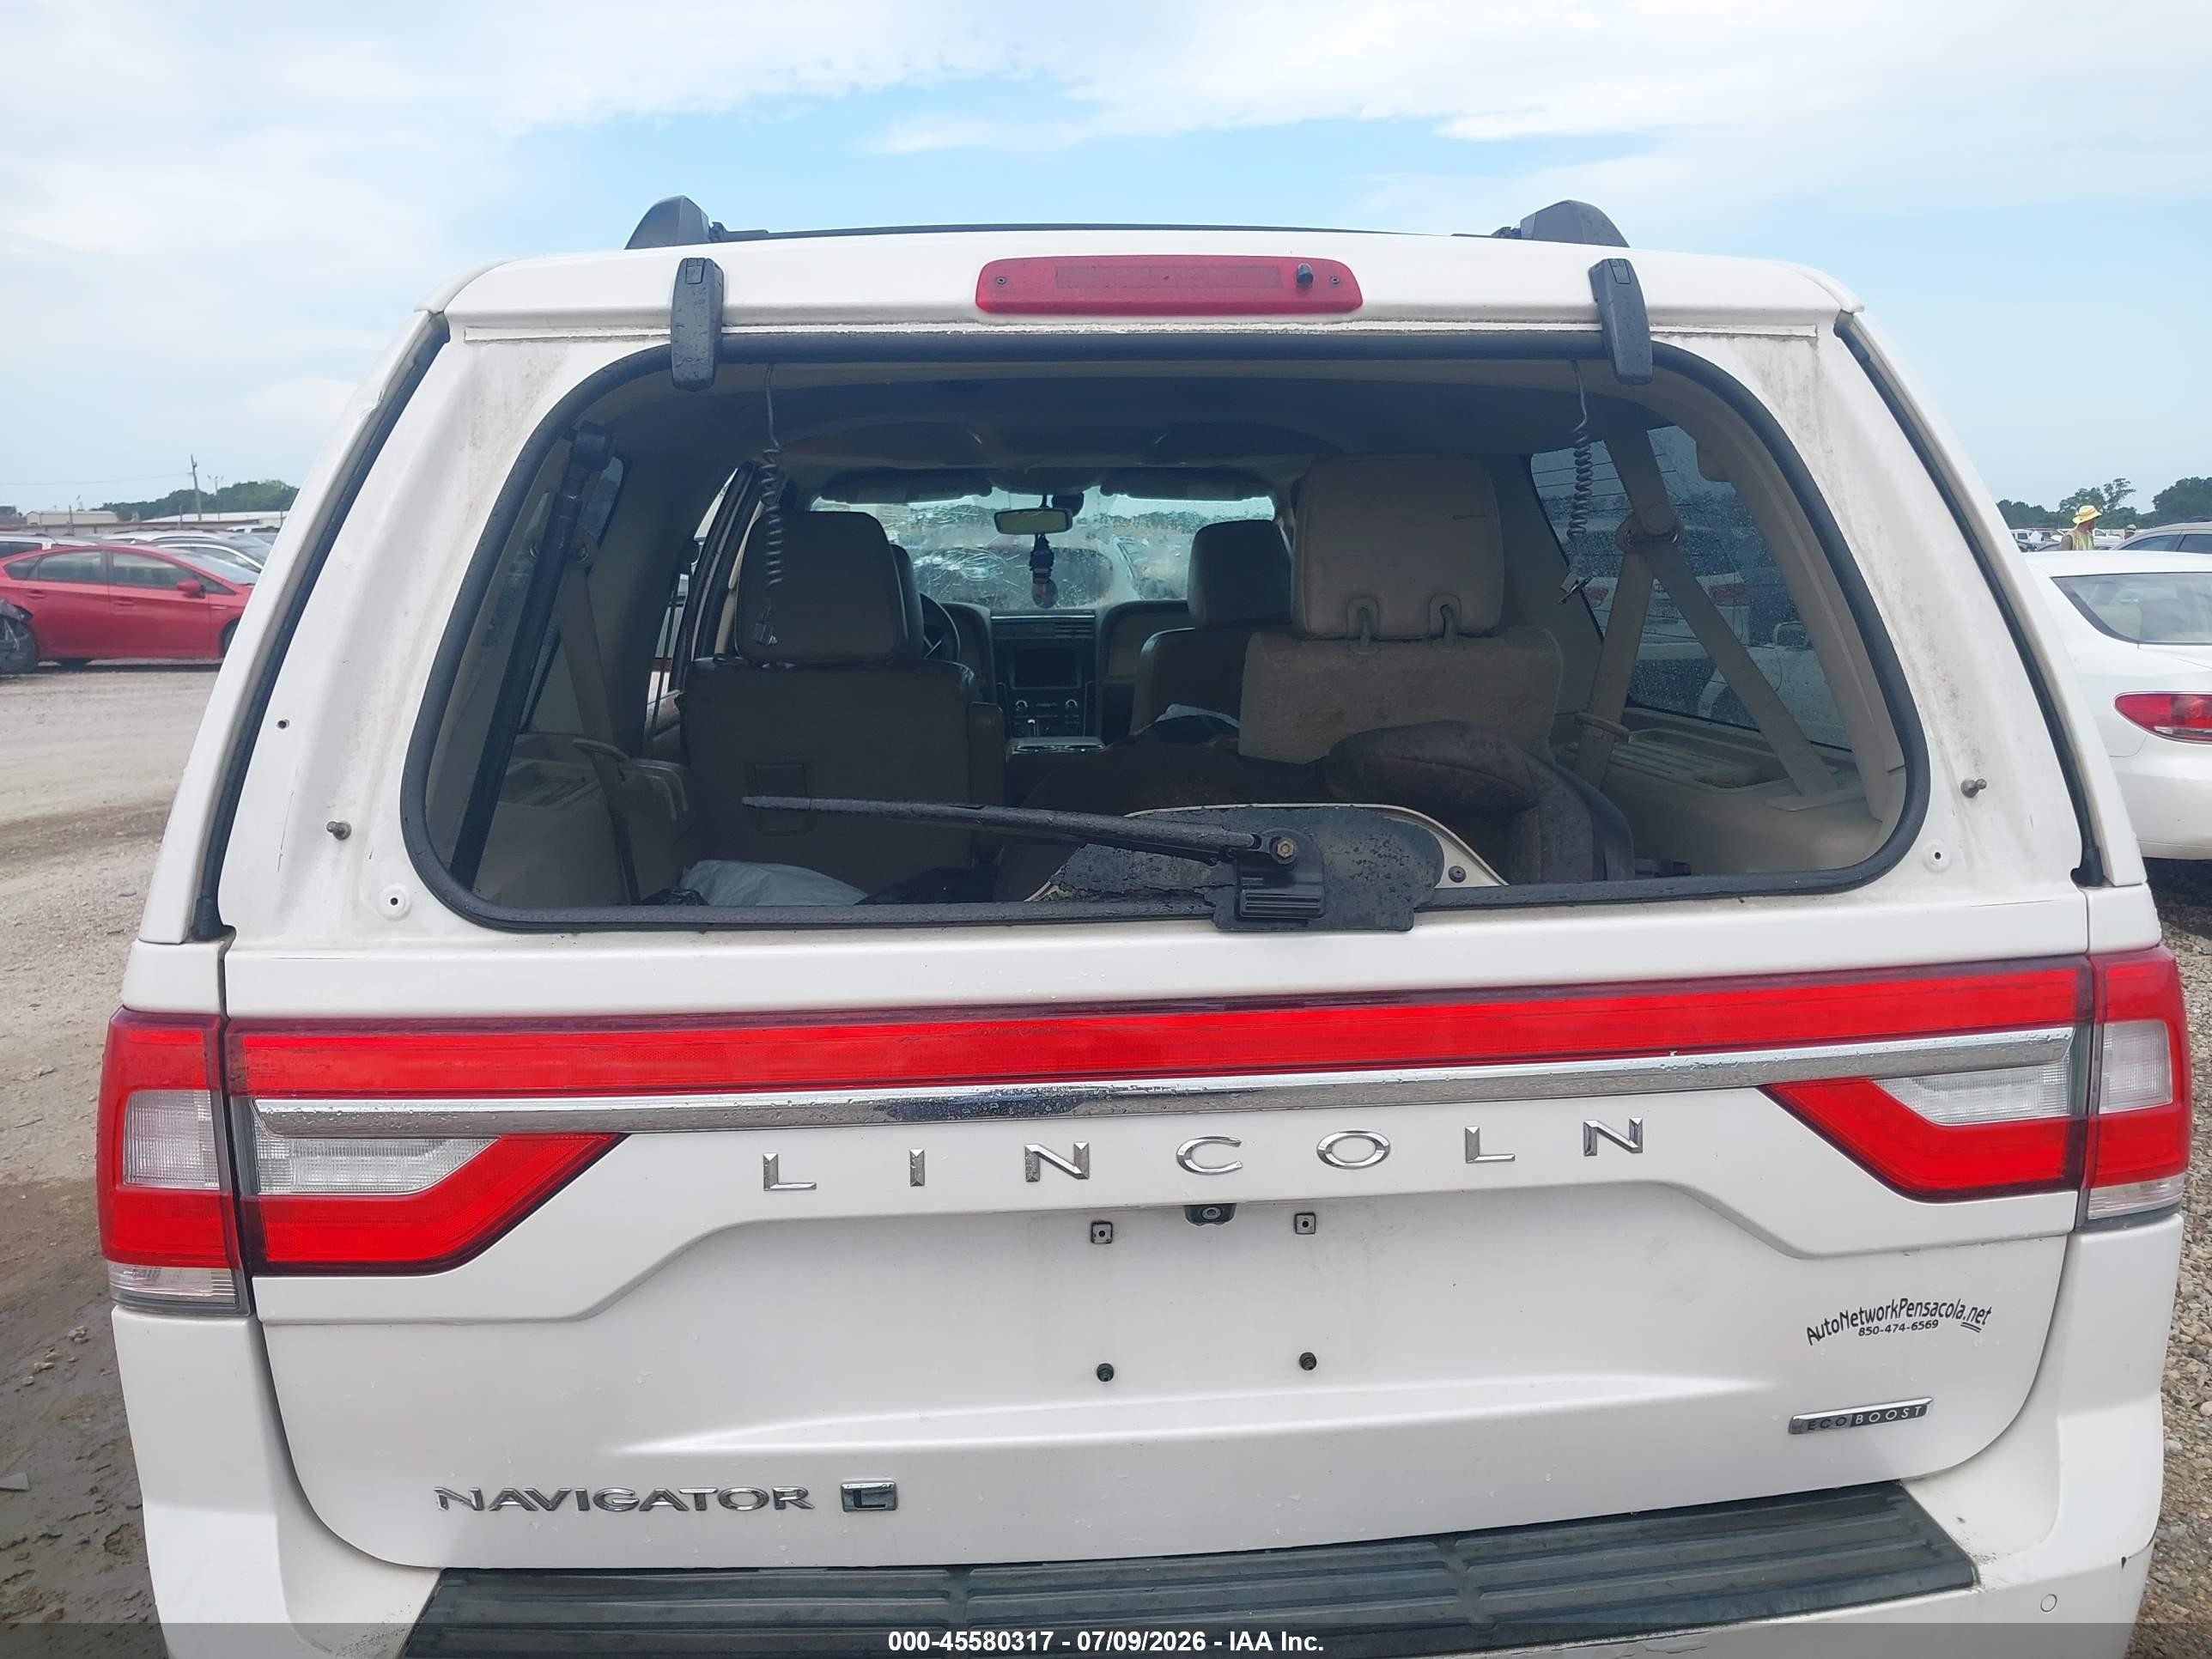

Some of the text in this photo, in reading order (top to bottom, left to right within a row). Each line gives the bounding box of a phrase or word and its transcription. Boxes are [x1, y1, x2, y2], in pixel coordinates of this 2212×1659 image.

[763, 1117, 1644, 1191] LINCOLN
[1806, 1298, 1992, 1346] AutoNetworkPensacola.net
[1857, 1320, 1939, 1336] 850-474-6569
[434, 1486, 815, 1512] NAVIGATOR
